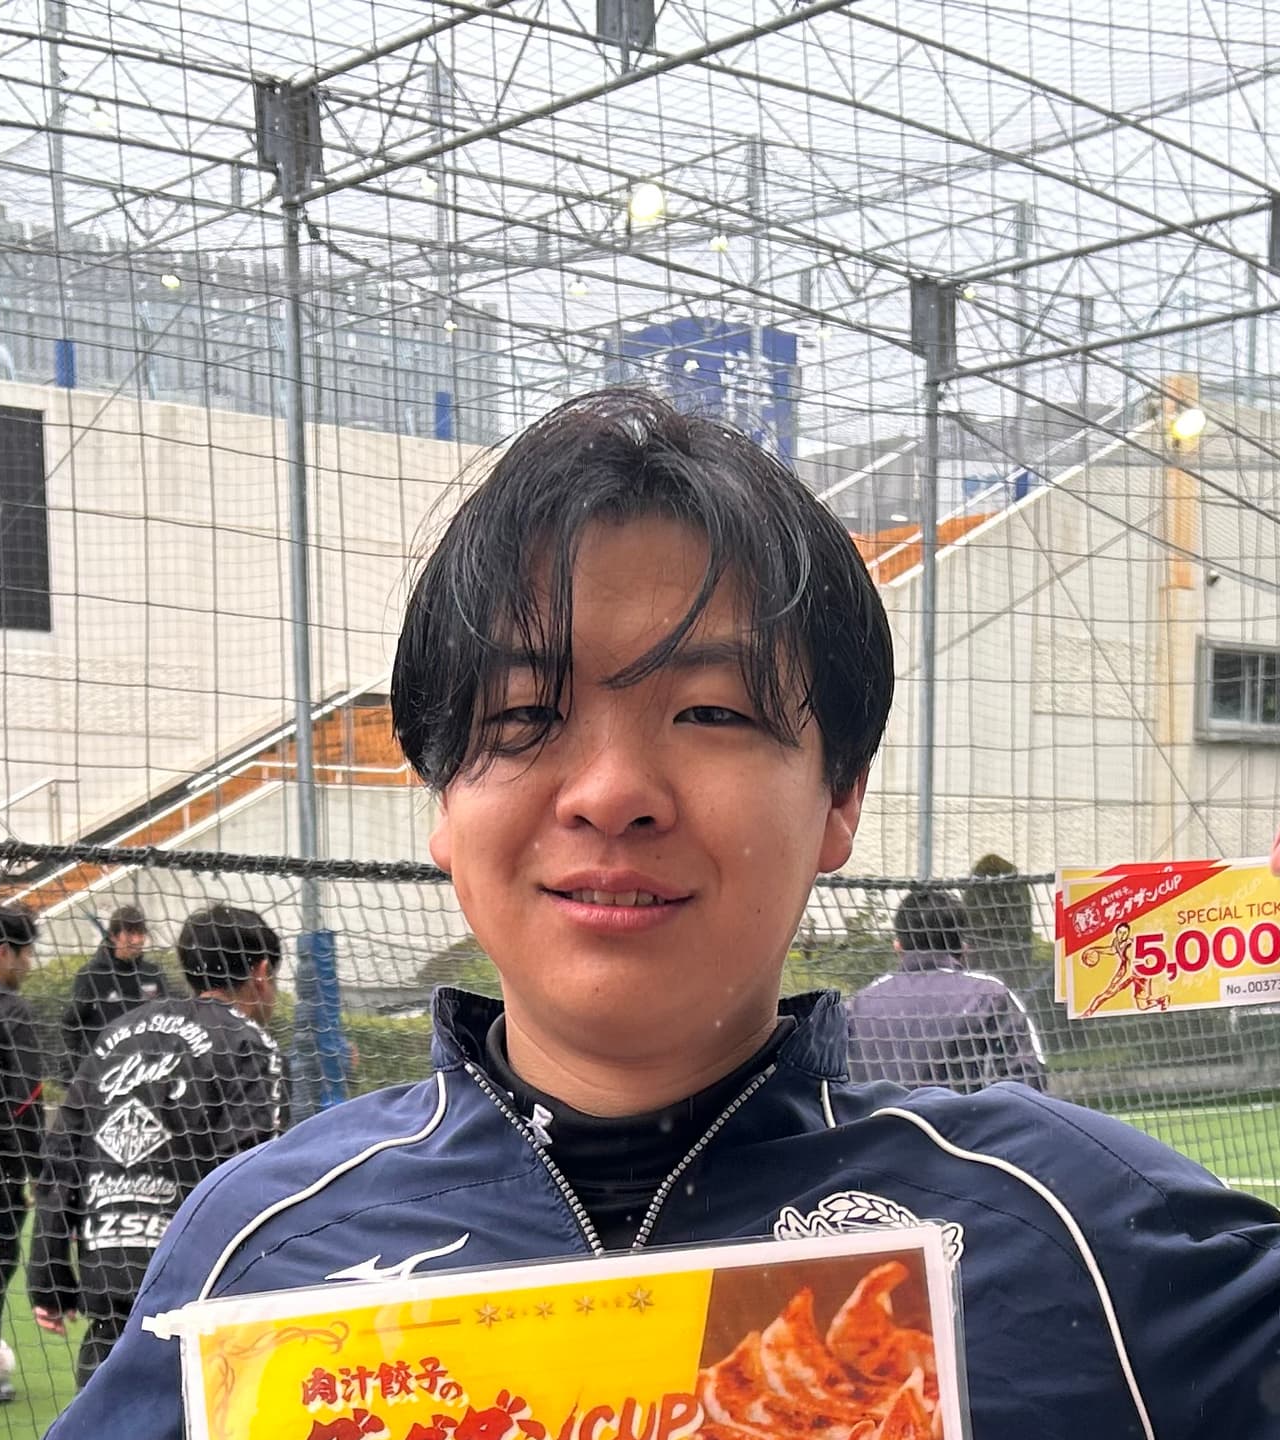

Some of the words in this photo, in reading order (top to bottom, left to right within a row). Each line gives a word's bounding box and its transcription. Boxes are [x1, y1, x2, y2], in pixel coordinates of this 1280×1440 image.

[1177, 904, 1243, 926] SPECIAL
[302, 1356, 466, 1406] 肉汁餃子の
